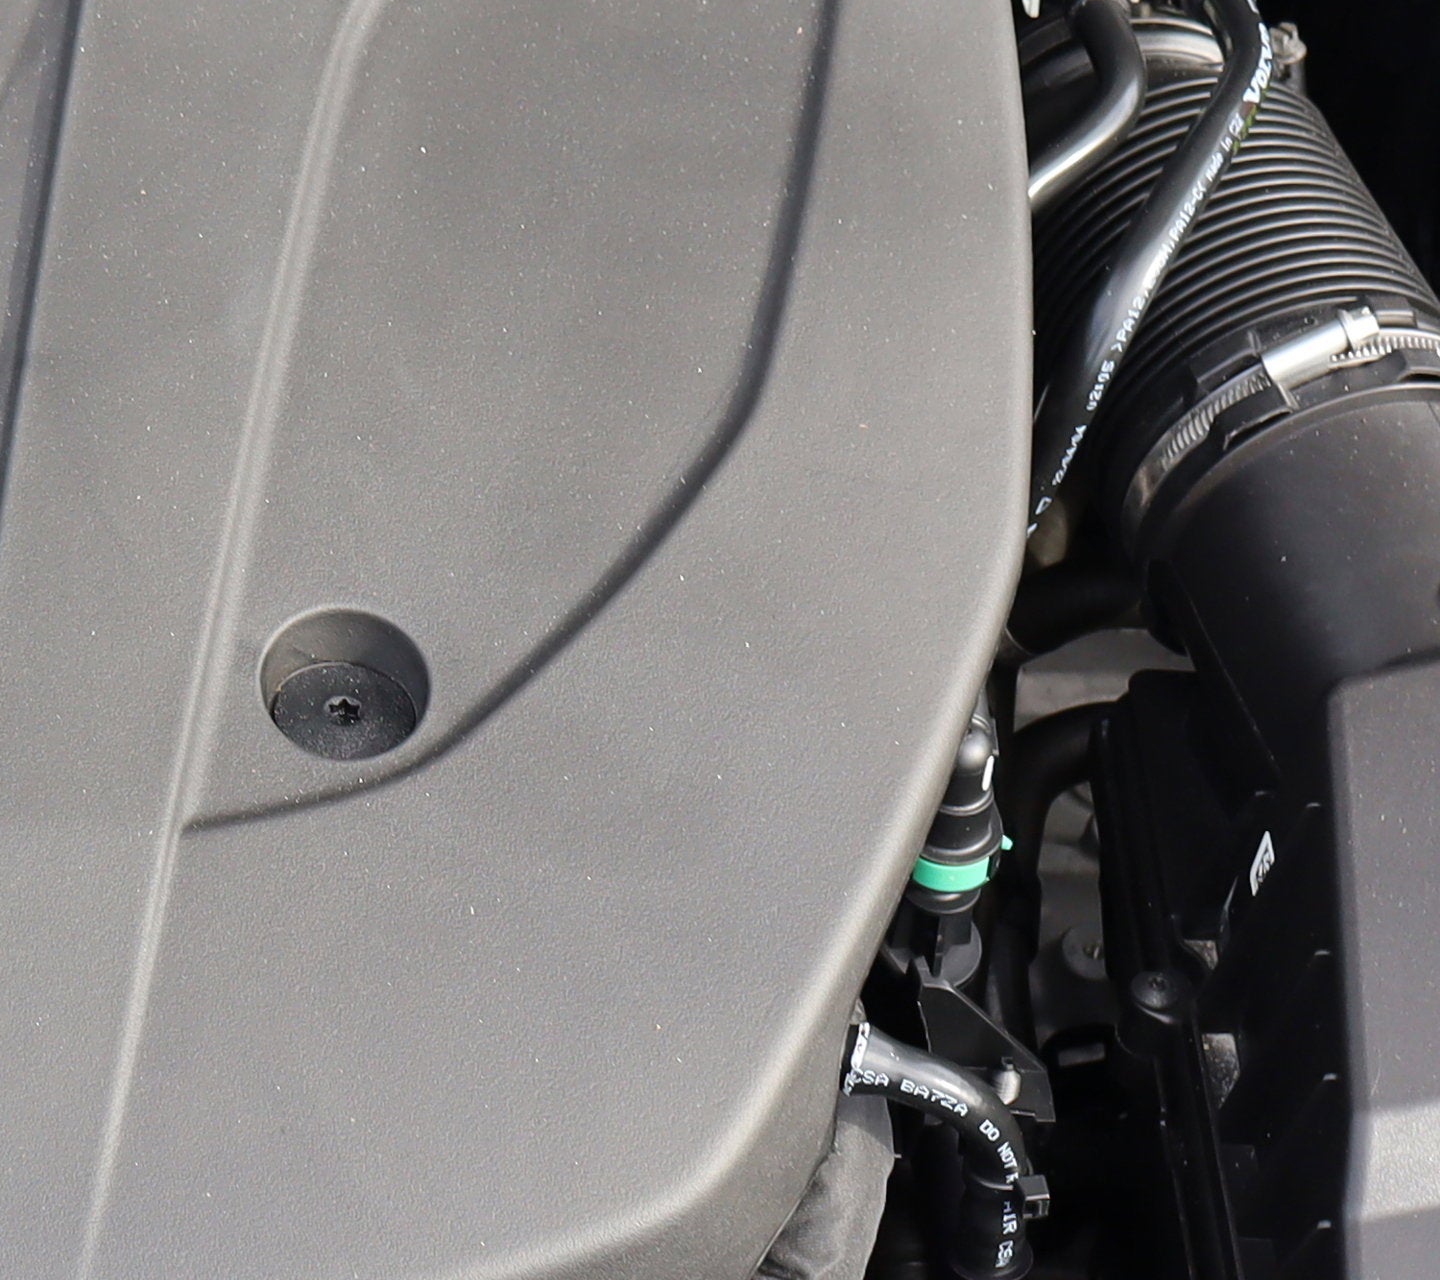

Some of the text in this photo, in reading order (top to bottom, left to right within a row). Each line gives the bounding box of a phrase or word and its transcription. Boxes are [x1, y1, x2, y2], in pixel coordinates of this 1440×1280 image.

[1243, 22, 1272, 103] VOLVO
[979, 1119, 1000, 1142] DO
[996, 1141, 1018, 1169] NOT
